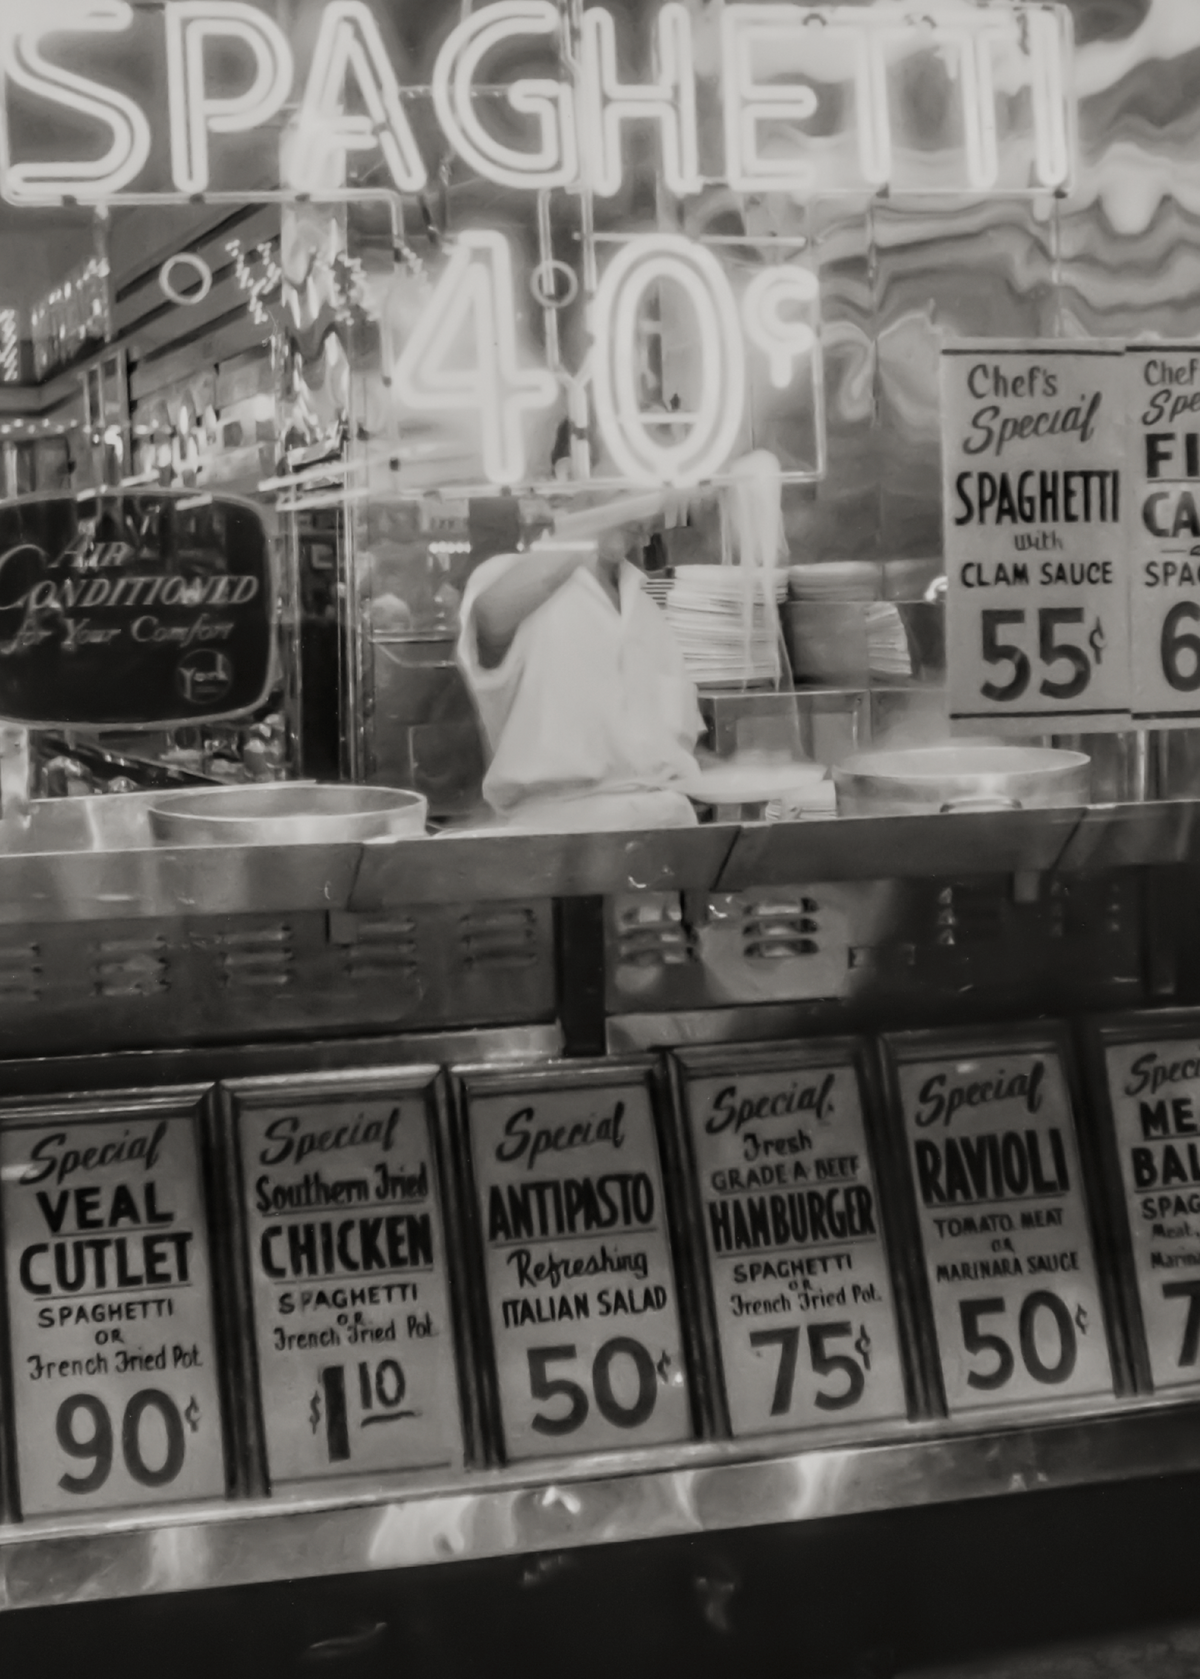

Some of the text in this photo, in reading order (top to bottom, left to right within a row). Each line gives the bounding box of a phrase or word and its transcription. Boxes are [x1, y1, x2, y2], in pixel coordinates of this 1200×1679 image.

[2, 0, 1066, 197] SPAGHETTI
[967, 363, 1058, 398] Chef's
[962, 391, 1102, 455] Special
[954, 469, 1120, 526] SPAGHETTI
[1013, 529, 1064, 551] with
[960, 560, 1113, 588] CLAM SAUCE
[914, 1061, 1045, 1128] Special
[19, 1120, 169, 1185] Special
[259, 1107, 401, 1165] Special
[495, 1101, 626, 1170] Special
[742, 1128, 813, 1162] Fresh
[710, 1155, 860, 1192] GRADE A BEEF
[914, 1127, 1070, 1204] RAVIOLI
[36, 1181, 175, 1233] VEAL
[256, 1161, 428, 1213] Southern Fried
[488, 1171, 655, 1241] ANTIPASTO
[708, 1184, 876, 1253] HAMBURGER
[932, 1207, 1064, 1240] TOMATO MEAT
[19, 1231, 193, 1295] CUTLET
[260, 1212, 434, 1279] CHICKEN
[506, 1244, 649, 1289] Refreshing
[733, 1253, 853, 1285] SPAGHETTI
[788, 1278, 813, 1293] OR
[936, 1251, 1080, 1283] MARINARA SAUCE
[38, 1298, 174, 1329] SPAGHETTI
[278, 1282, 418, 1315] SPAGHETTI
[336, 1311, 365, 1327] OR
[501, 1284, 668, 1329] ITALIAN SALAD
[730, 1293, 791, 1318] French
[797, 1286, 846, 1312] Fried
[94, 1328, 125, 1345] OR
[273, 1326, 340, 1352] French
[346, 1318, 396, 1345] Fried
[27, 1352, 108, 1381] French
[115, 1344, 166, 1374] Fried
